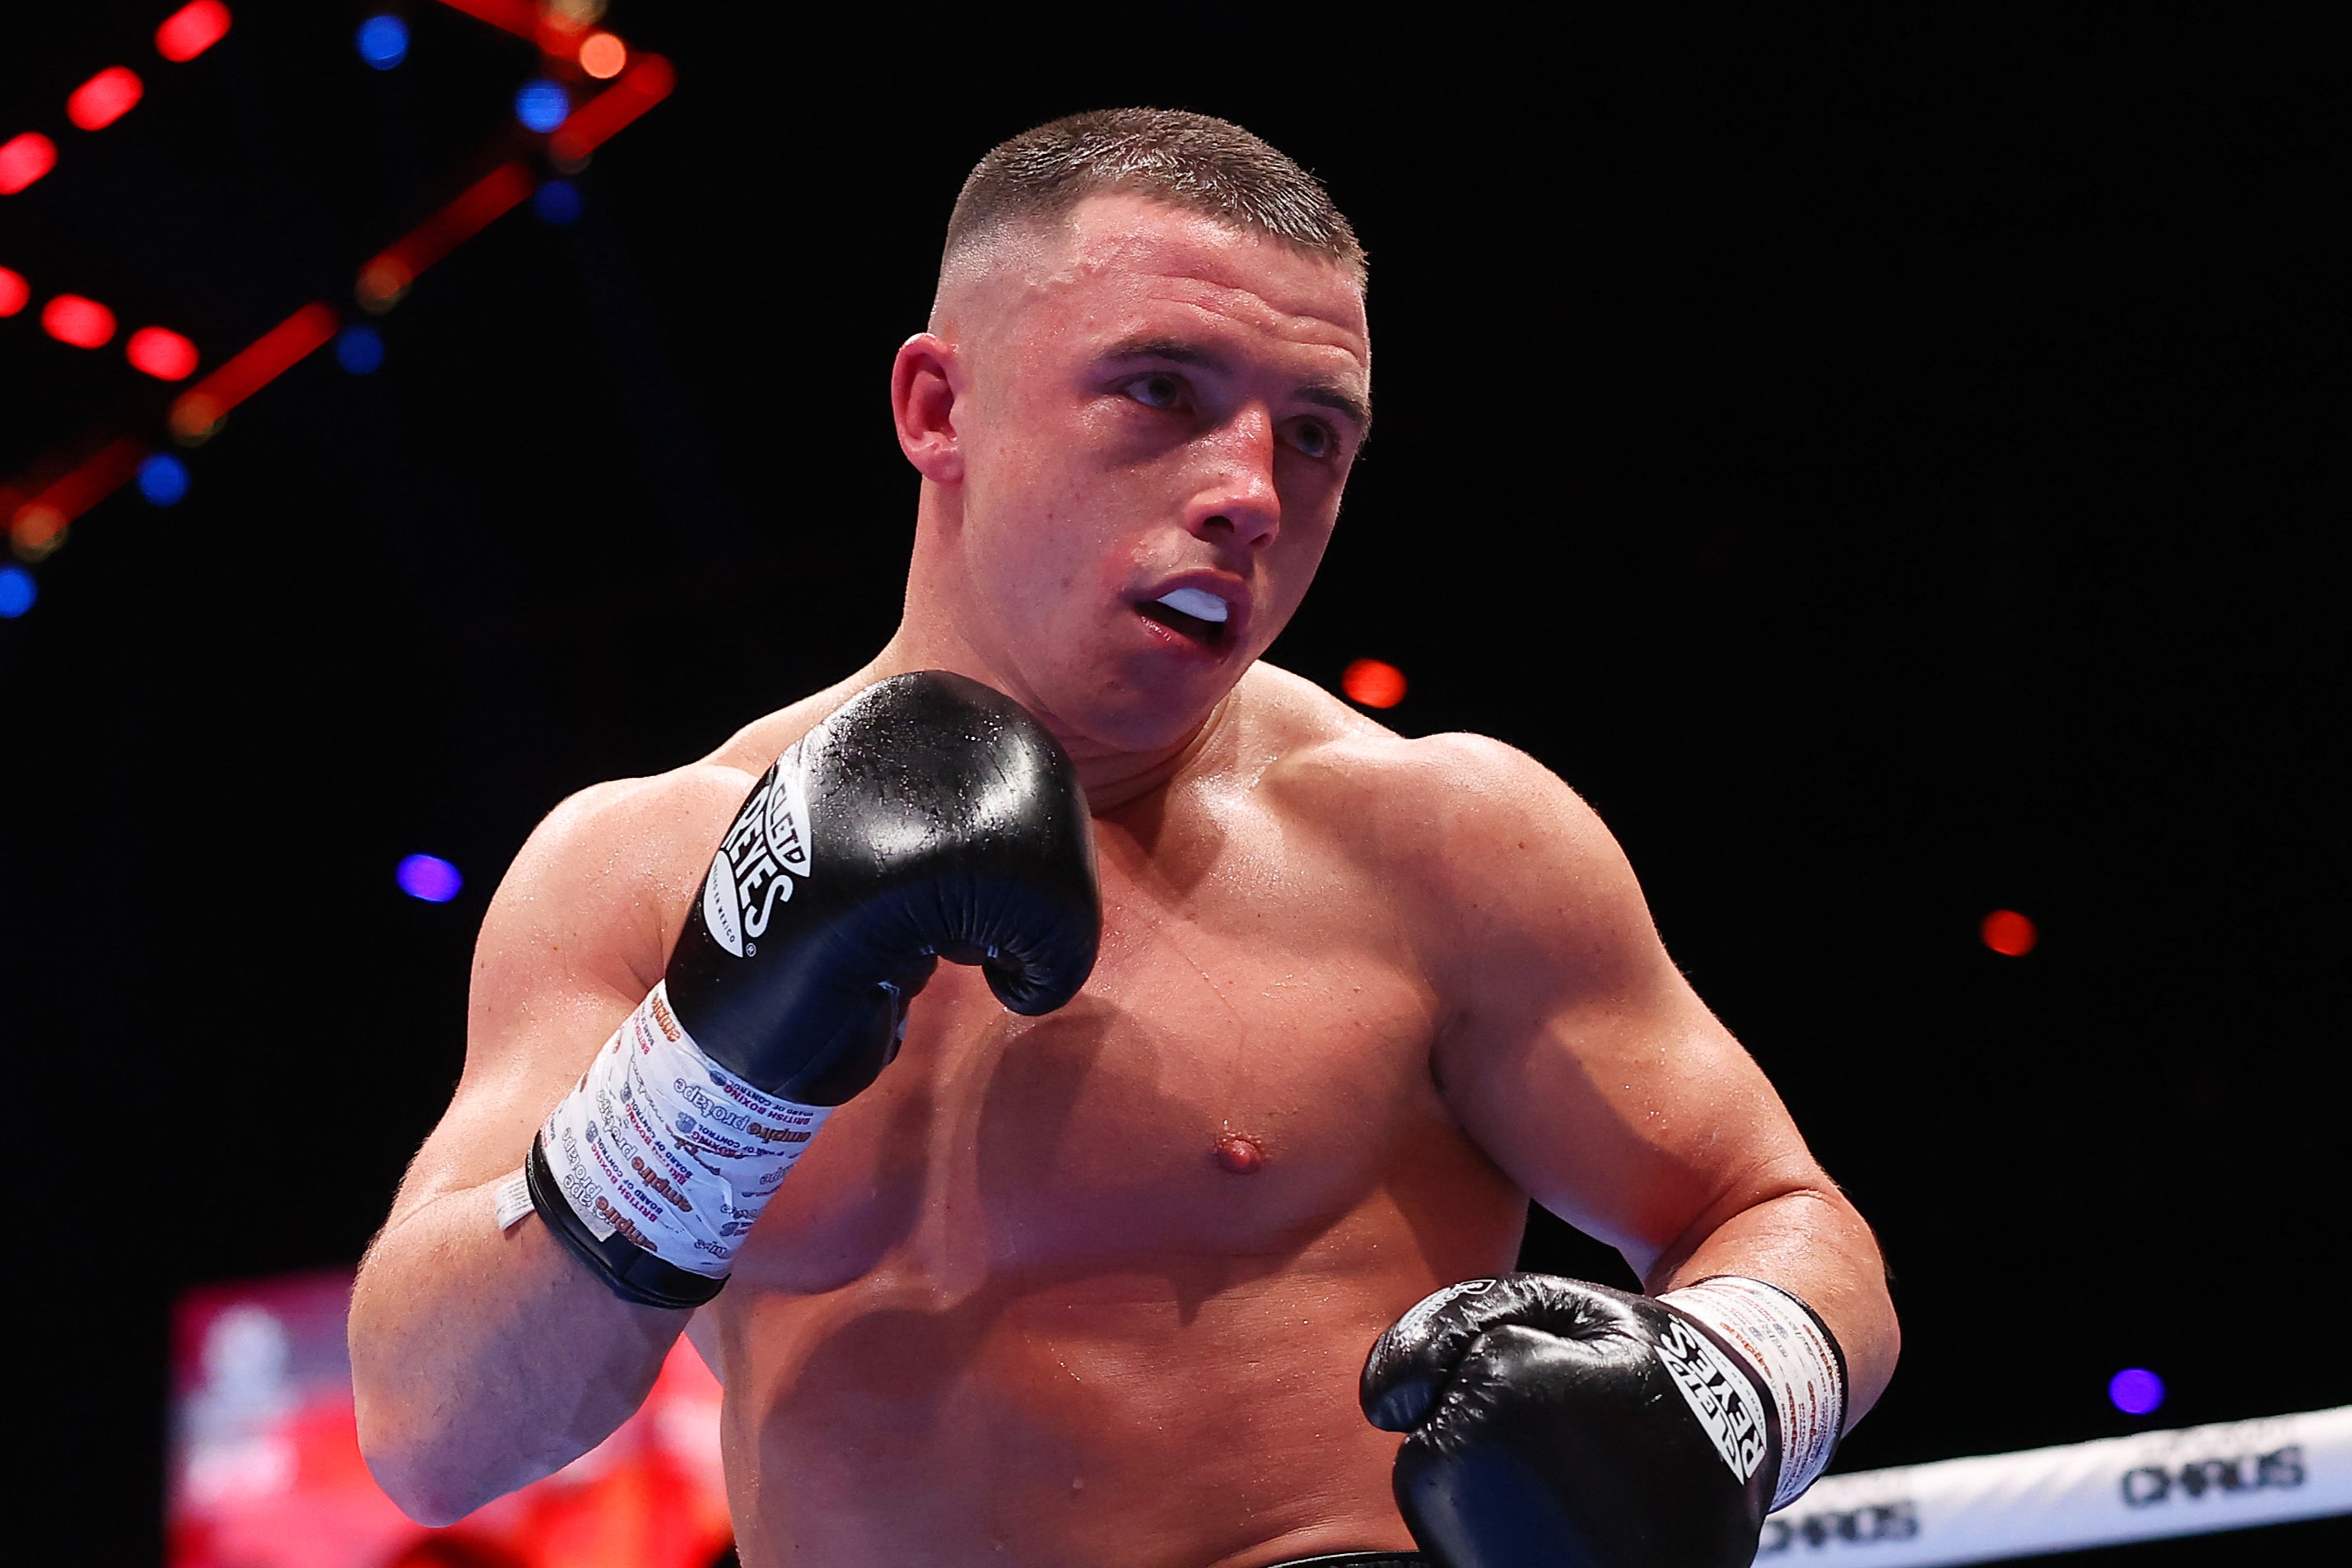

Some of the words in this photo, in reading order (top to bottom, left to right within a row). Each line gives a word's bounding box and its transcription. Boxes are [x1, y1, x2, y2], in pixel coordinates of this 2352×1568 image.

[721, 784, 794, 938] REYES
[717, 907, 736, 944] MEXICO
[723, 1083, 767, 1114] BOXING
[561, 1126, 603, 1198] protape
[590, 1143, 618, 1185] BOXING
[597, 1136, 624, 1178] CONTROL
[617, 1184, 659, 1223] BRITISH
[631, 1156, 693, 1212] empire
[634, 1189, 664, 1215] BOARD
[1660, 1318, 1767, 1480] REYES
